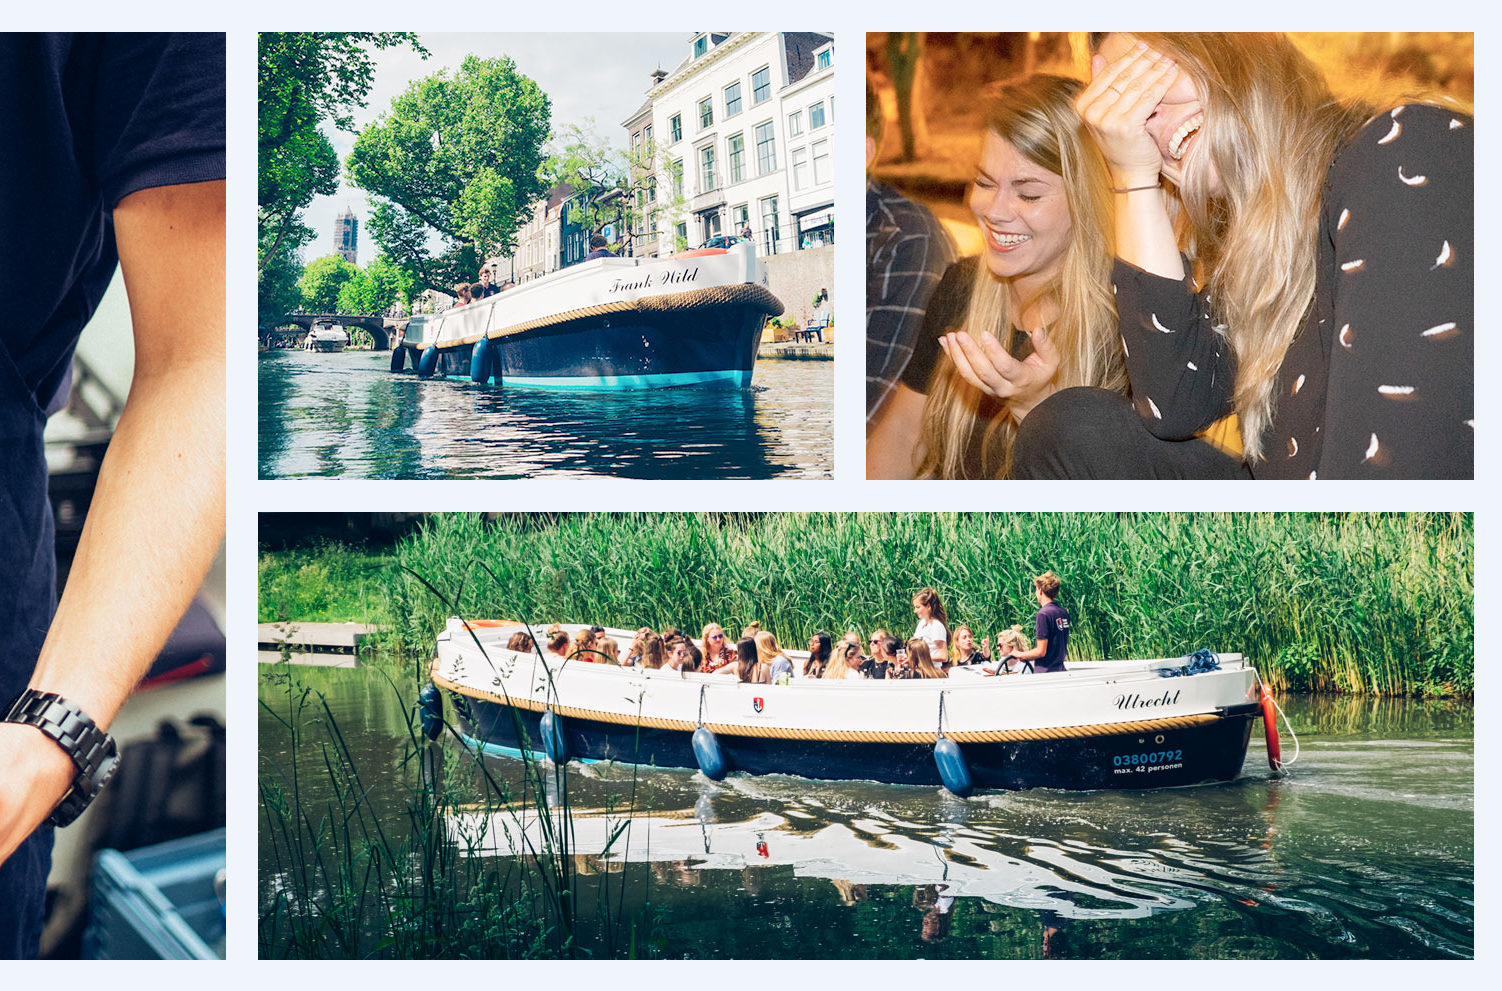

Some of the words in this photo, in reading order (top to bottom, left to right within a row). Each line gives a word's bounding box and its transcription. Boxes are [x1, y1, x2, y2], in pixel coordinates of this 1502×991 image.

[608, 274, 652, 293] Frank
[661, 267, 699, 285] Wild
[1113, 689, 1180, 710] Utrecht
[1113, 749, 1183, 767] 03800792
[1135, 765, 1146, 773] 42
[1148, 763, 1183, 773] personen
